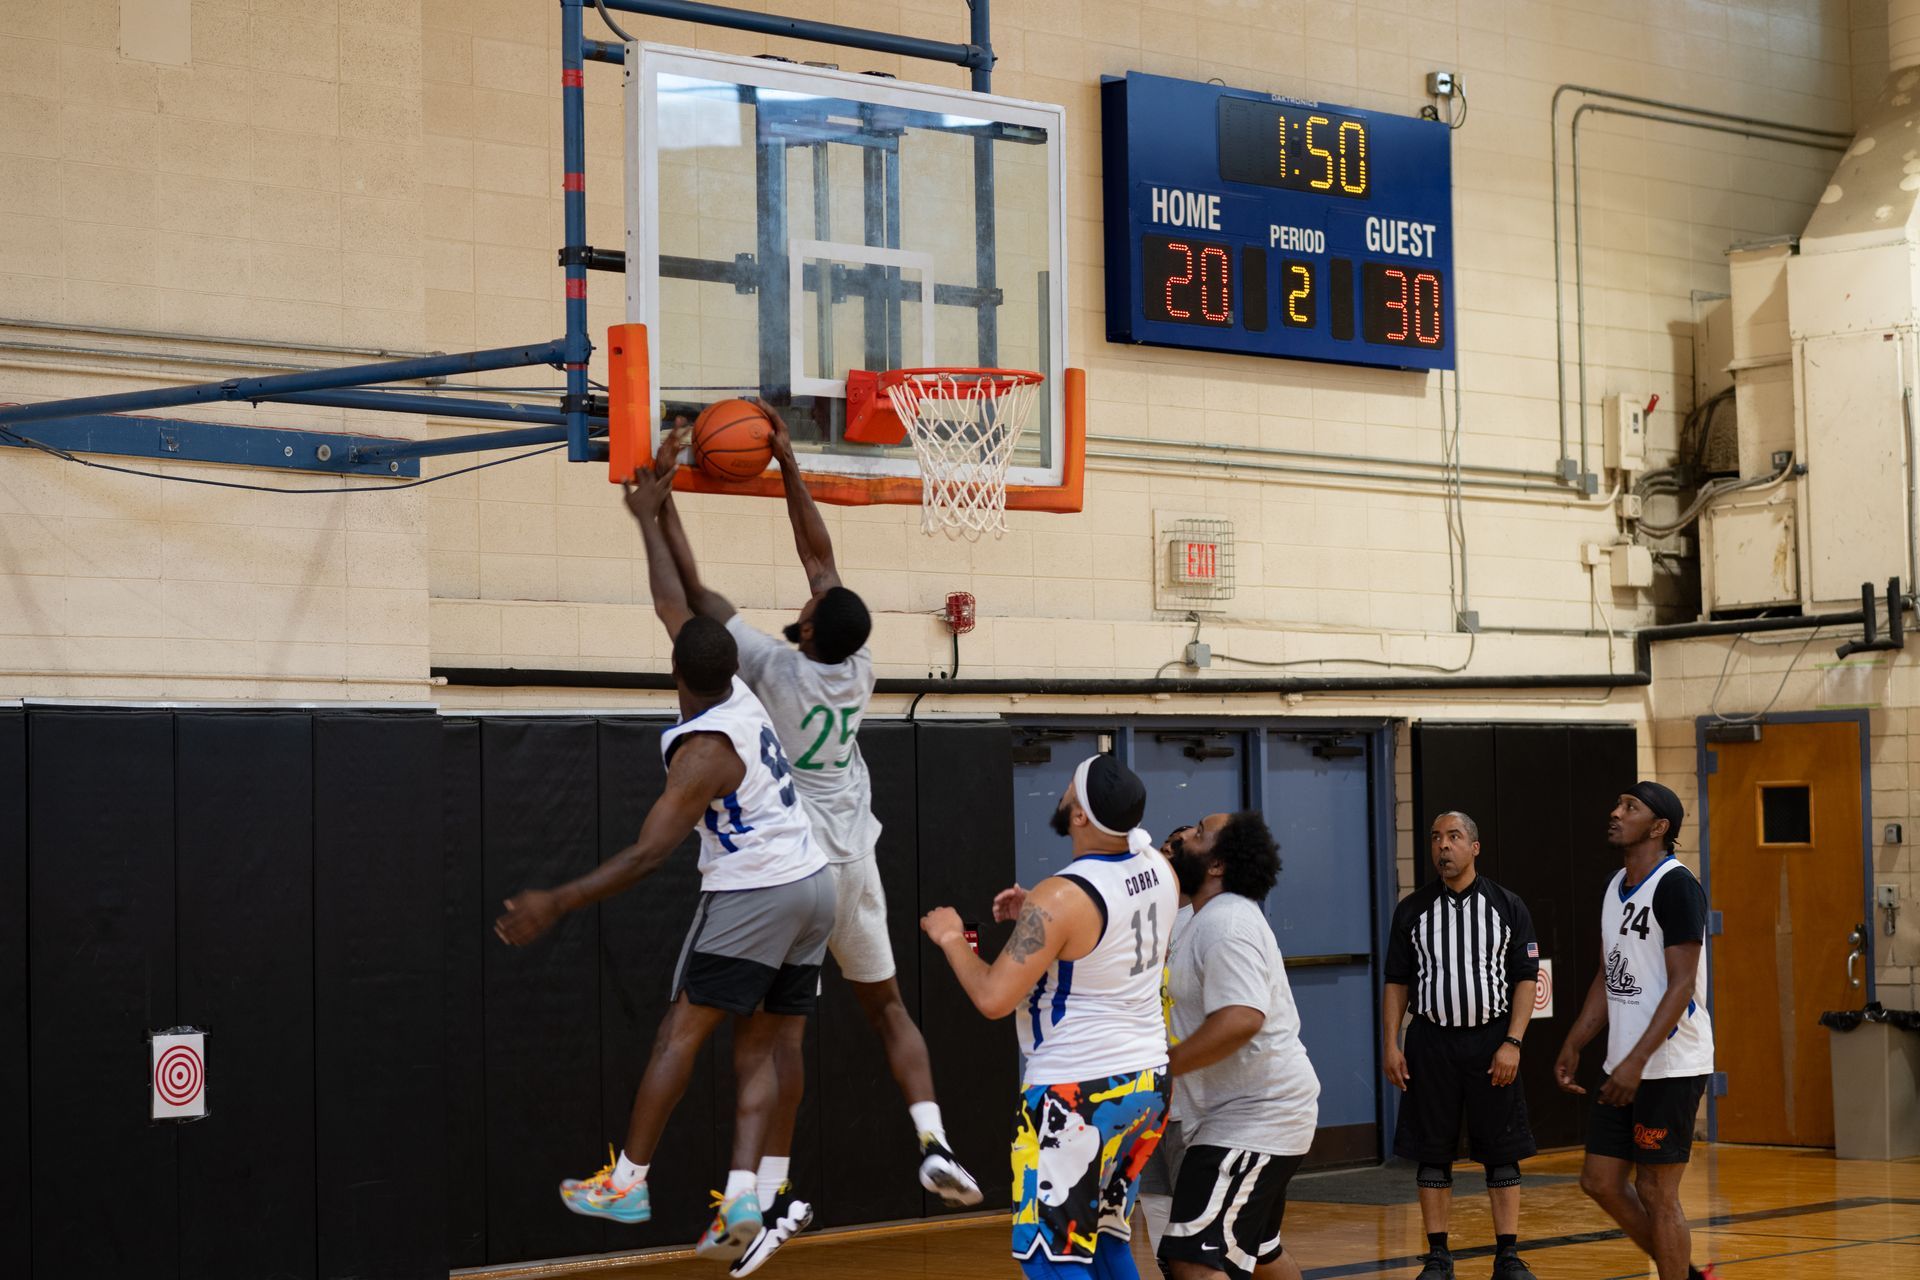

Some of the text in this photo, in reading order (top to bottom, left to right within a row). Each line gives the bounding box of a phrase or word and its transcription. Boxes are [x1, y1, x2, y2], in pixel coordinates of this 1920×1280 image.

[1280, 116, 1366, 194] 1:50
[1152, 187, 1221, 231] HOME
[1270, 224, 1325, 254] PERIOD
[1366, 216, 1436, 258] GUEST
[1166, 243, 1229, 322] 20
[1289, 266, 1310, 323] 2
[1386, 269, 1440, 344] 30
[1187, 543, 1217, 578] EXIT
[794, 704, 860, 770] 25
[1125, 868, 1160, 897] COBRA
[1129, 902, 1159, 977] 11
[1619, 902, 1650, 940] 24
